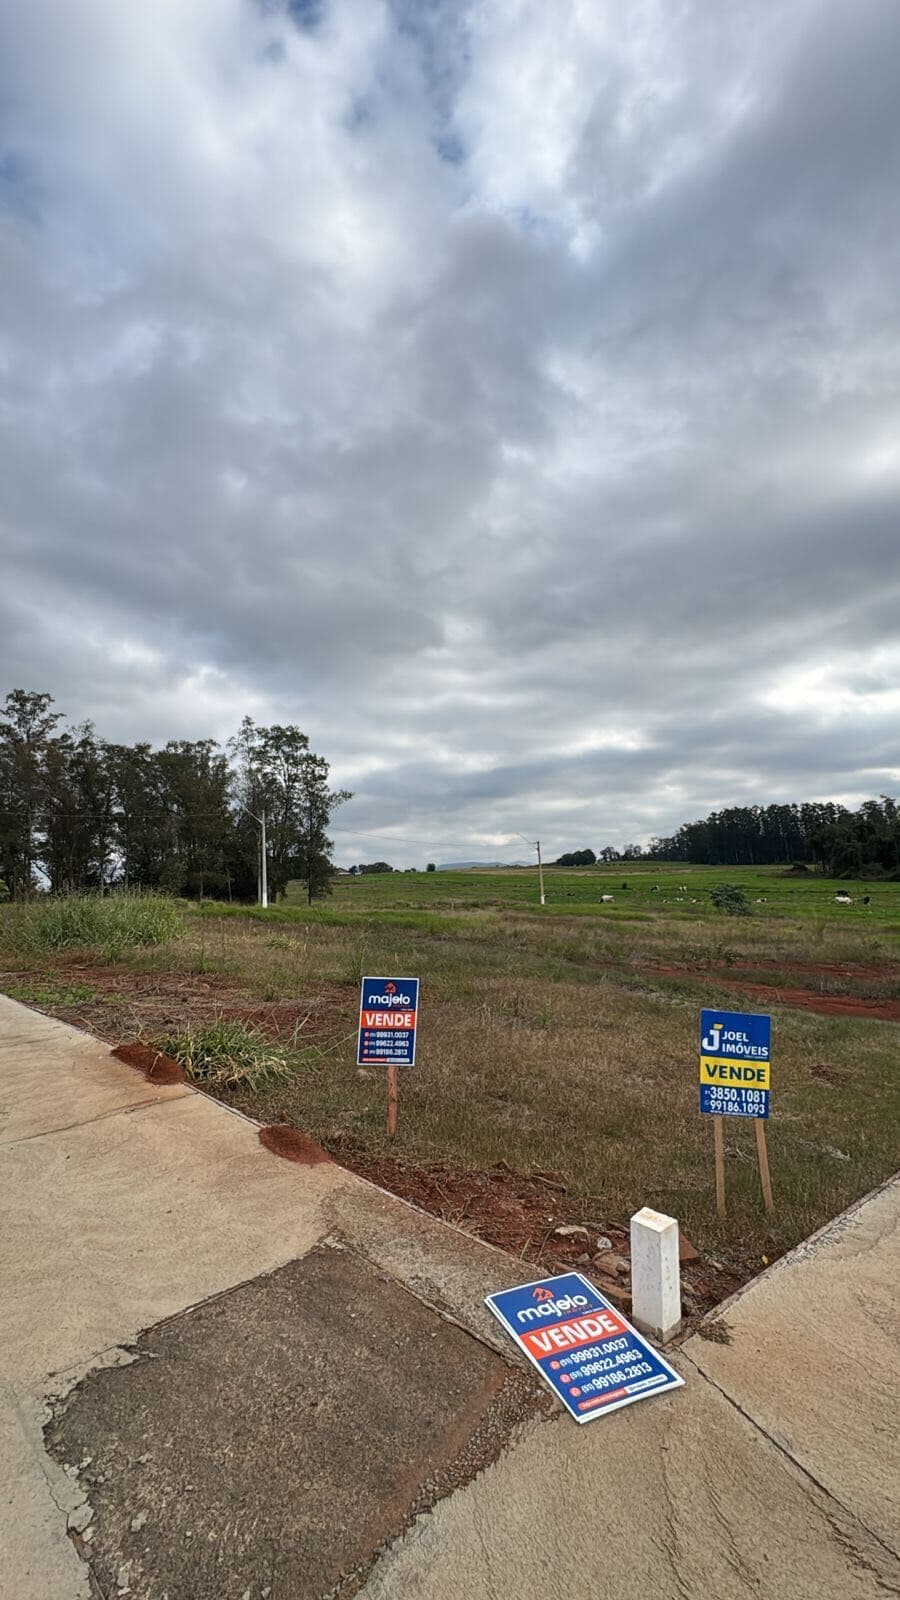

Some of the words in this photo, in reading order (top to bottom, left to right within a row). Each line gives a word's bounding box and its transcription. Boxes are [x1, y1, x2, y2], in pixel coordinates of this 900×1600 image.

[368, 993, 410, 1008] majelo
[365, 1013, 413, 1027] VENDE
[721, 1030, 749, 1042] JOEL
[721, 1042, 769, 1056] IMÓVEIS
[705, 1063, 766, 1083] VENDE
[710, 1086, 766, 1103] 3850.1081
[710, 1099, 766, 1114] 99186.1093
[516, 1293, 588, 1324] majelo
[528, 1313, 619, 1352] VENDE
[570, 1337, 629, 1364] 99931.0037
[591, 1361, 653, 1390] 99186.2813
